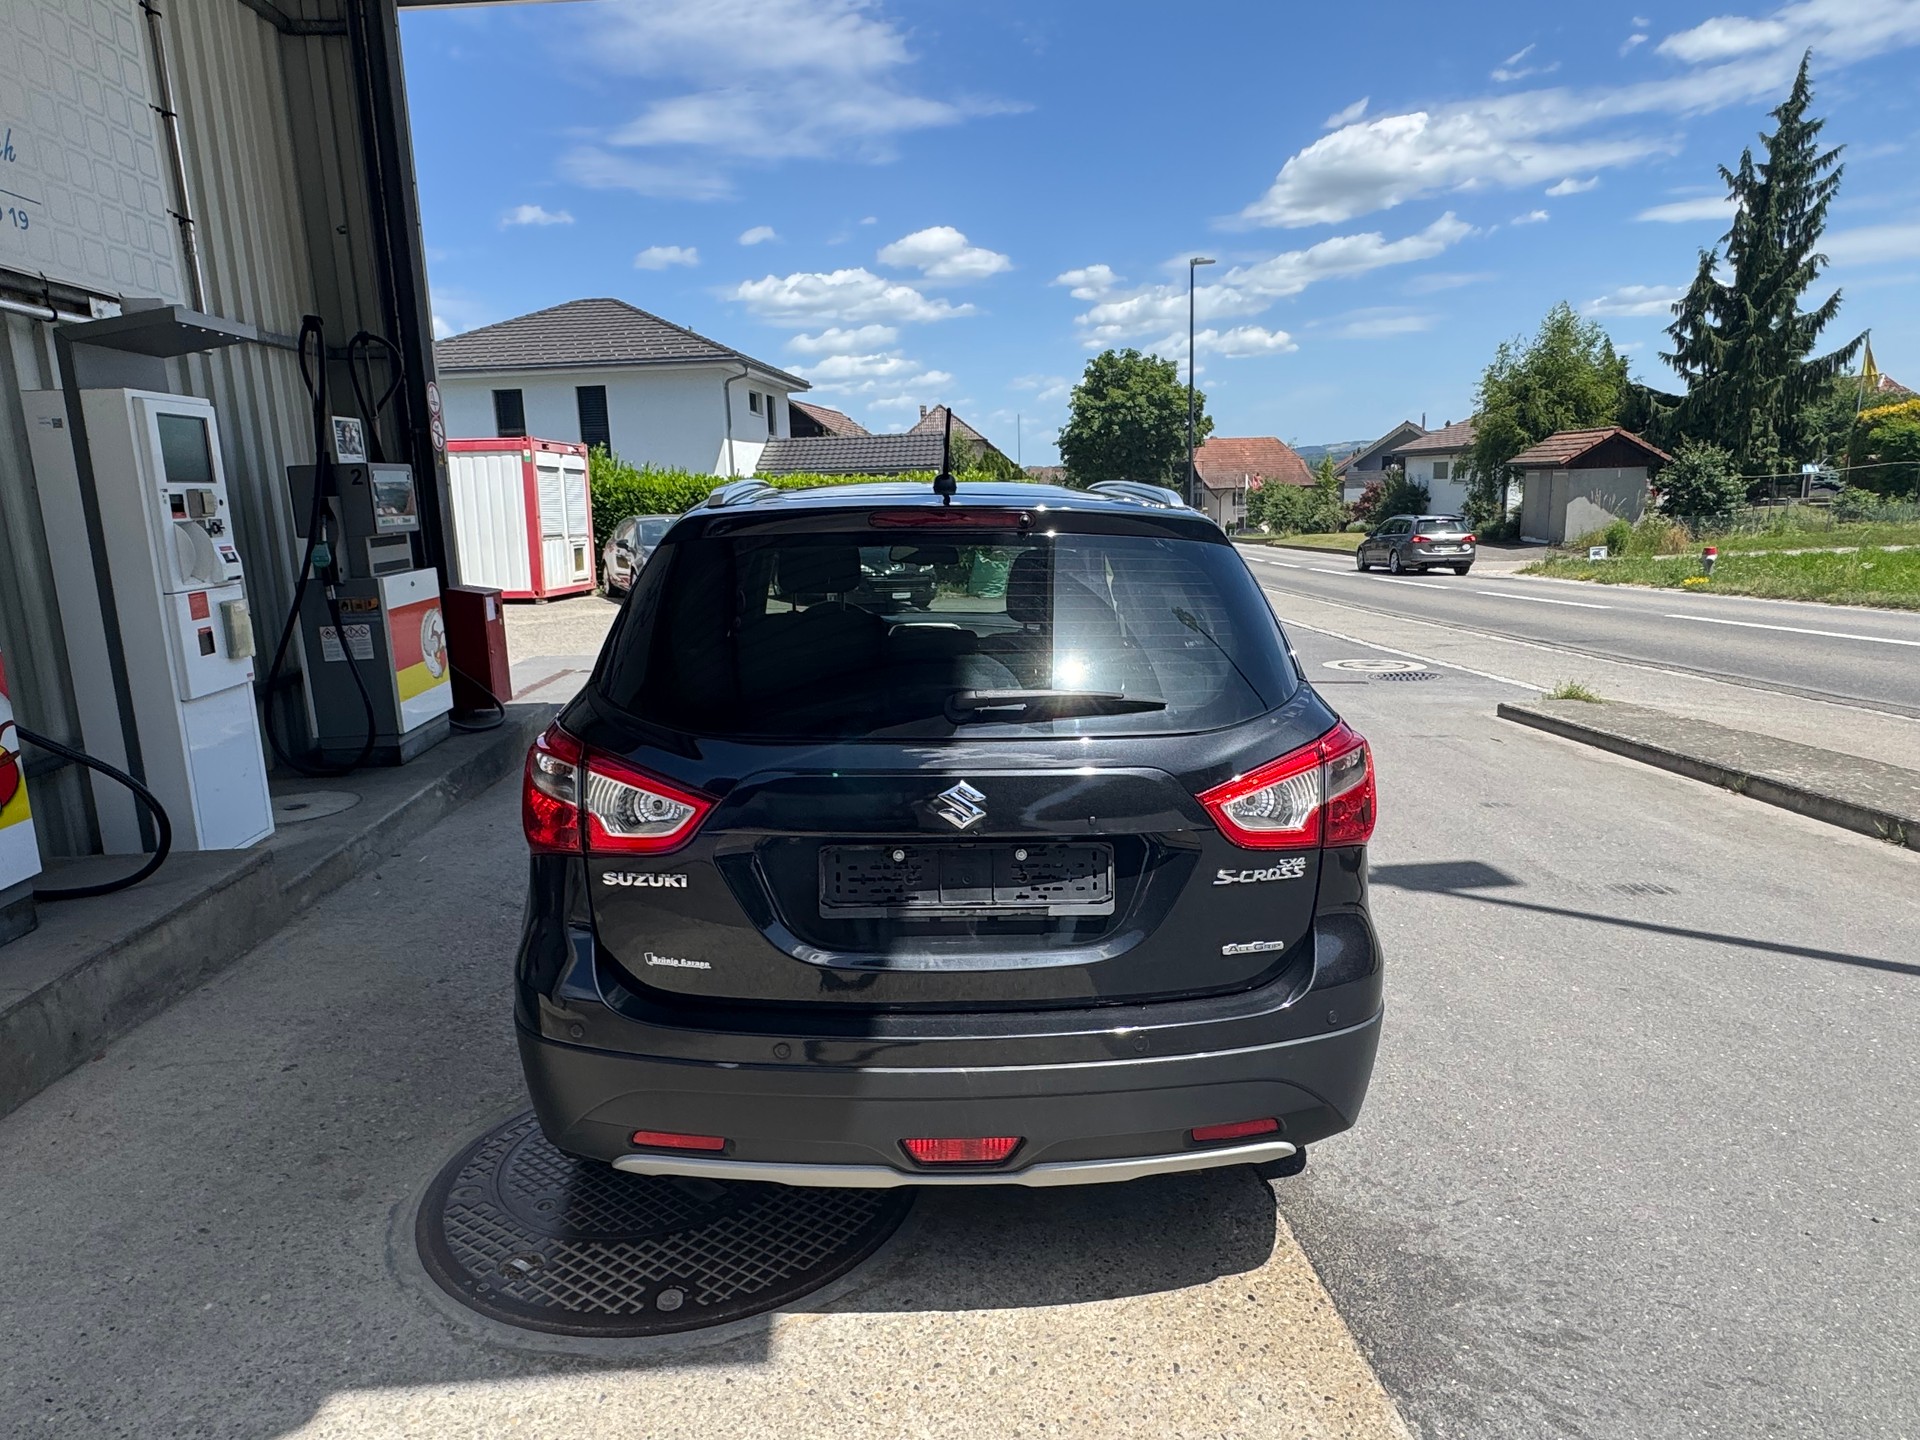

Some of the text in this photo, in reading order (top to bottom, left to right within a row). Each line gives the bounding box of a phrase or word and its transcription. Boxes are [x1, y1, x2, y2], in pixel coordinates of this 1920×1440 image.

[350, 468, 363, 486] 2
[1277, 856, 1306, 868] SX4
[602, 871, 688, 888] SUZUKI
[1212, 866, 1306, 885] S-CROSS
[680, 958, 711, 970] Garage
